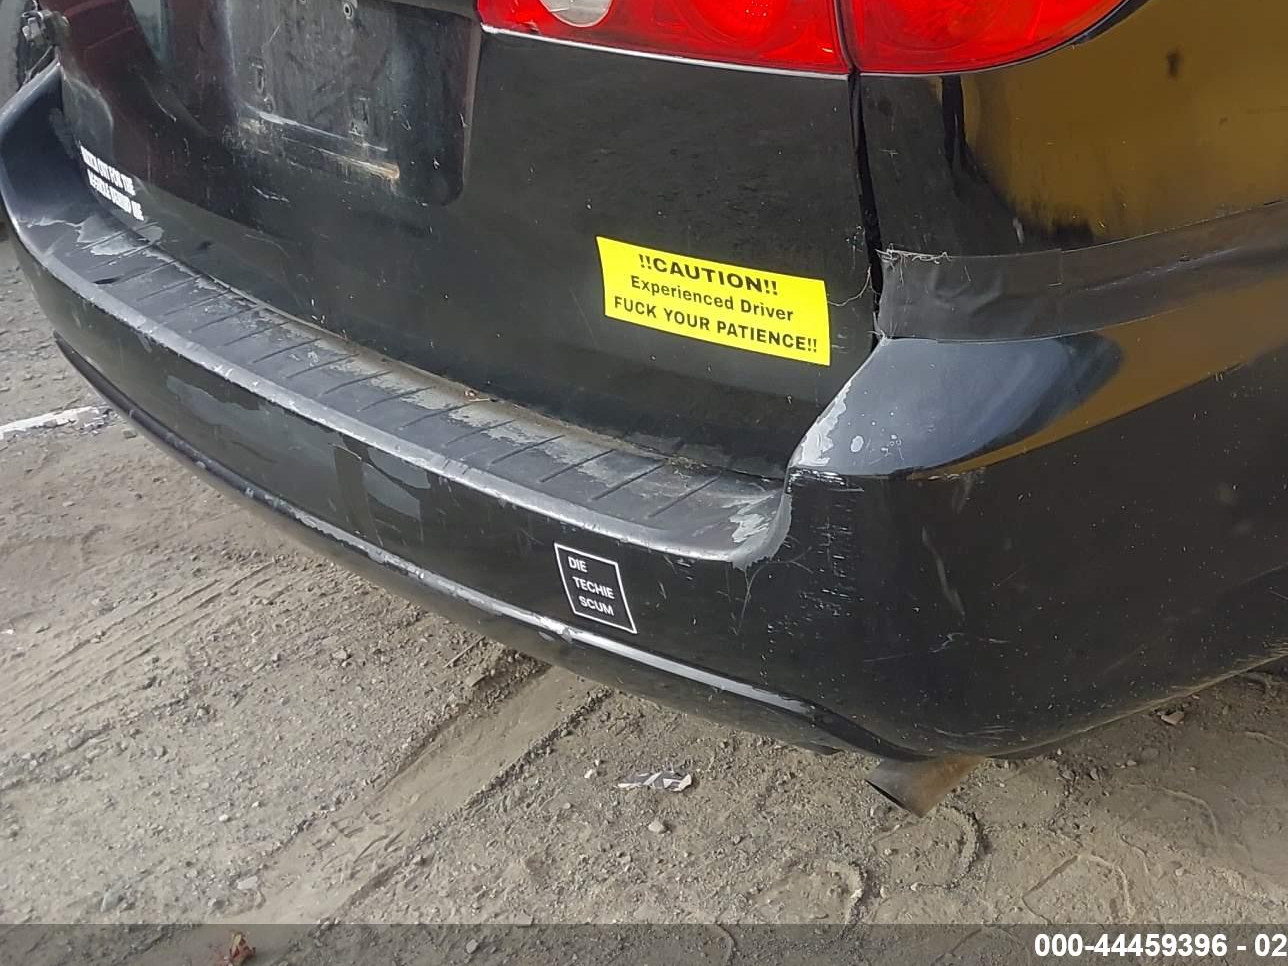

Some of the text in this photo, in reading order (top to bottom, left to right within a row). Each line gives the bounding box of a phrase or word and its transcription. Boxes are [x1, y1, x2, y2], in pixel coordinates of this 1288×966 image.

[638, 253, 778, 296] !!CAUTION!!
[631, 275, 794, 321] Experienced Driver
[614, 295, 817, 353] FUCK YOUR PATIENCE!!
[567, 555, 588, 573] DIE
[572, 575, 615, 600] TECHIE
[578, 595, 615, 616] SCUM
